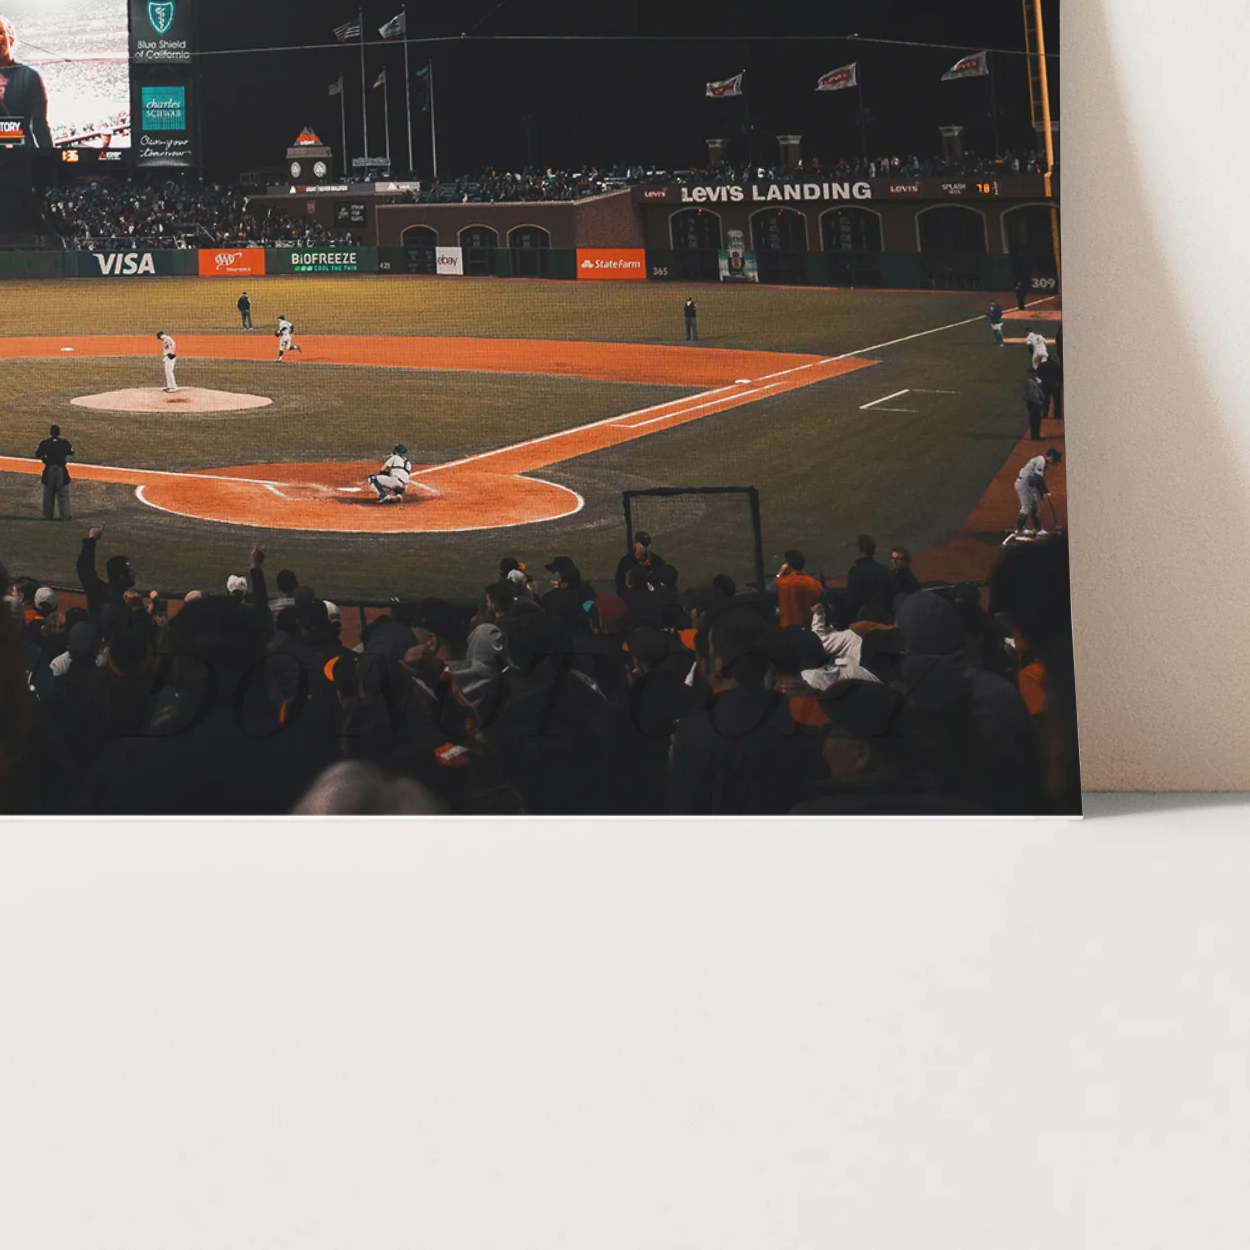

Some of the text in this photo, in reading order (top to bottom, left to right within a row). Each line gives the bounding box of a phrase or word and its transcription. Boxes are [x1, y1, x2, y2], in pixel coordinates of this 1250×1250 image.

[137, 39, 187, 50] Blue Shield
[146, 49, 191, 60] California
[751, 182, 873, 201] LANDING
[91, 252, 157, 276] VISA
[436, 254, 458, 267] ebay
[652, 266, 669, 276] 365
[1030, 277, 1056, 289] 309
